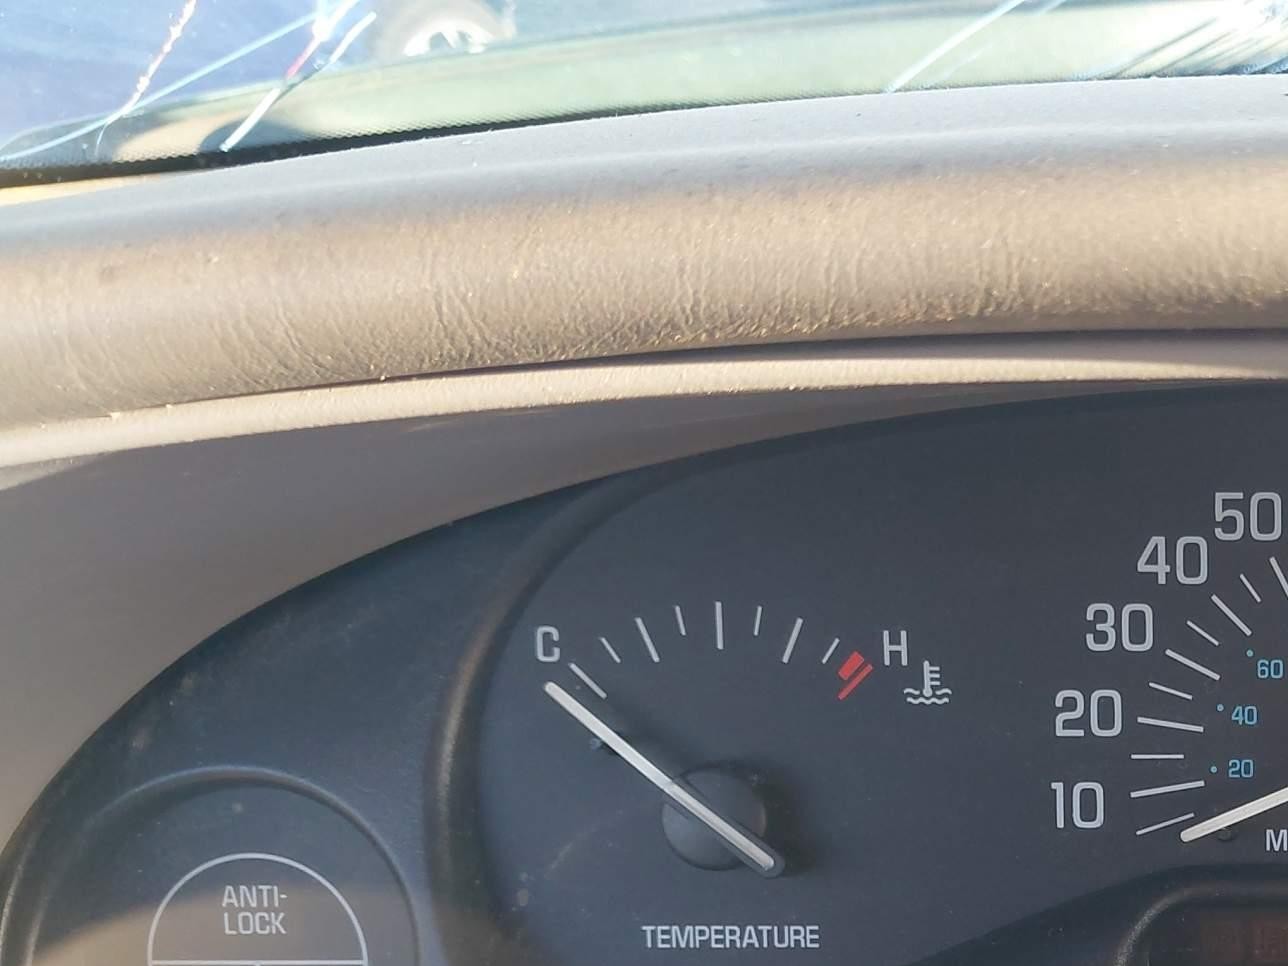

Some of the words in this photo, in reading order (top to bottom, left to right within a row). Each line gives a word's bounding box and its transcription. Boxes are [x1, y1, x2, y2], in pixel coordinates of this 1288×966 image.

[1214, 491, 1282, 541] 50
[1137, 535, 1208, 585] 40
[536, 625, 561, 663] C
[1085, 602, 1154, 652] 30
[882, 629, 908, 666] H
[1256, 659, 1284, 679] 60
[1054, 689, 1122, 737] 20
[1231, 705, 1258, 726] 40
[1228, 759, 1254, 778] 20
[1050, 781, 1104, 829] 10
[221, 884, 288, 909] ANTI-
[223, 911, 287, 935] LOCK
[641, 925, 820, 949] TEMPERATURE
